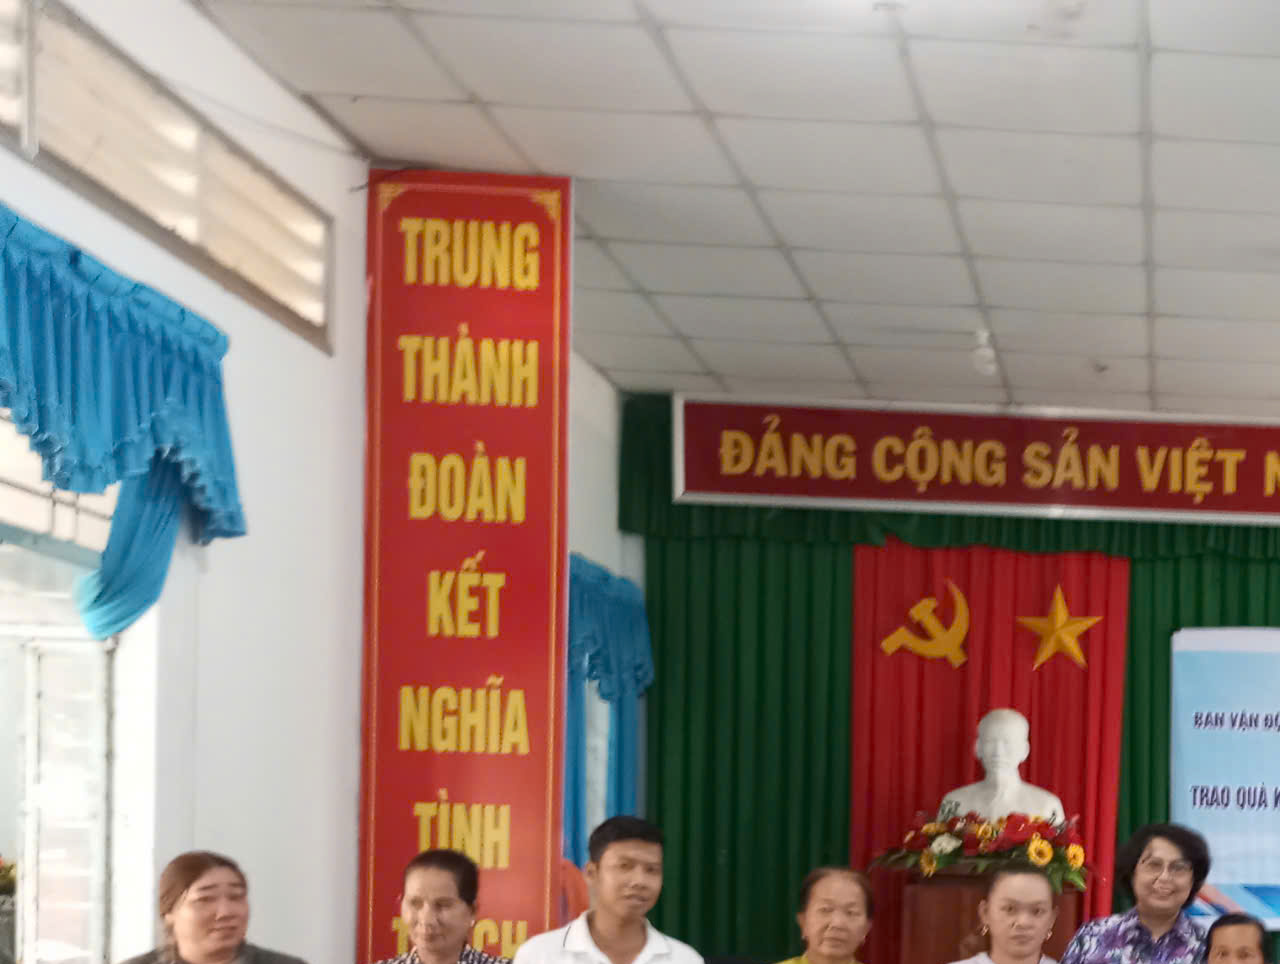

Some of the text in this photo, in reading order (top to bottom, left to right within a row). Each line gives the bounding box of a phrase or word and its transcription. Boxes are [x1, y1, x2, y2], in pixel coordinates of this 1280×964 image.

[399, 216, 540, 291] TRUNG
[398, 322, 539, 407] THÀNH
[408, 440, 527, 524] ĐOÀN
[719, 414, 858, 481] ĐẢNG
[872, 426, 1006, 493] CỘNG
[1022, 427, 1120, 491] SẢN
[1135, 437, 1246, 503] VIỆT
[427, 550, 506, 639] KẾT
[398, 674, 530, 755] NGHĨA
[1194, 711, 1225, 729] BAN
[1190, 785, 1231, 809] TRAO
